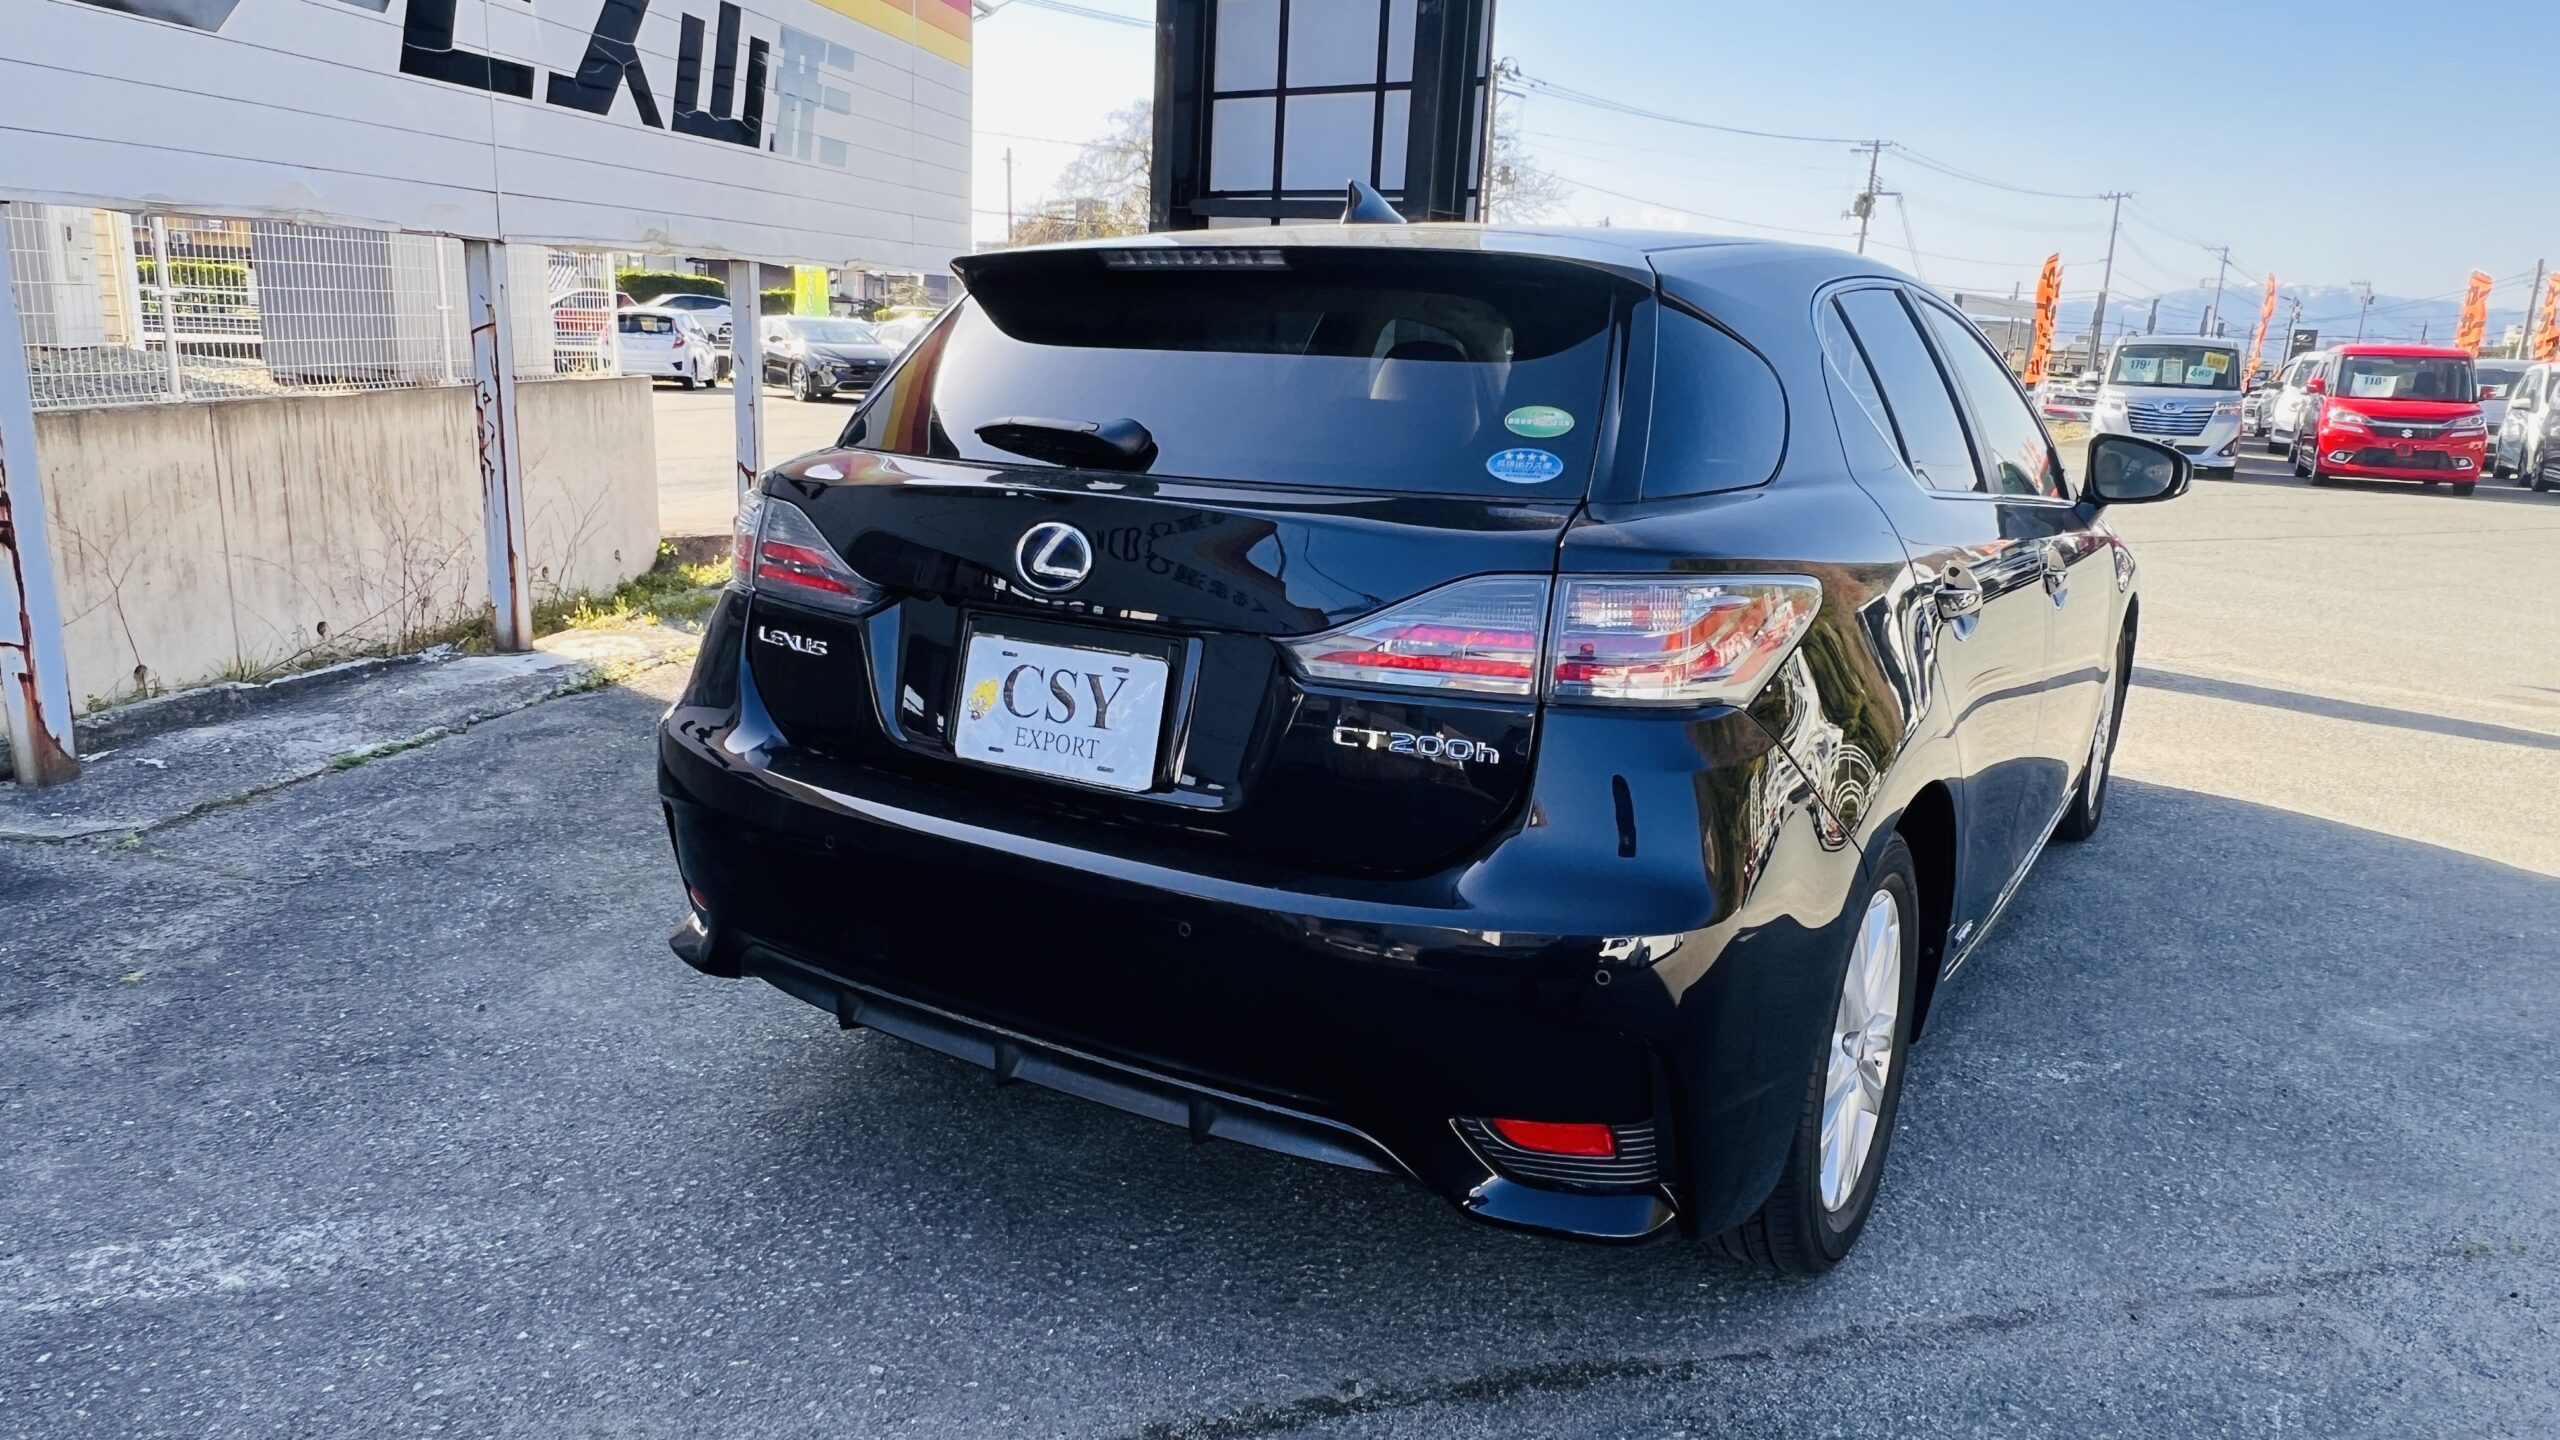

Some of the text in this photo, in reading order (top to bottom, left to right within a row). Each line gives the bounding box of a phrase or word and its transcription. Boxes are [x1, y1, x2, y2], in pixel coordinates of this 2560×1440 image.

[759, 625, 827, 656] LEXUS
[1003, 664, 1129, 731] CSY
[1014, 726, 1100, 760] EXPORT
[1333, 725, 1500, 764] CT200h
